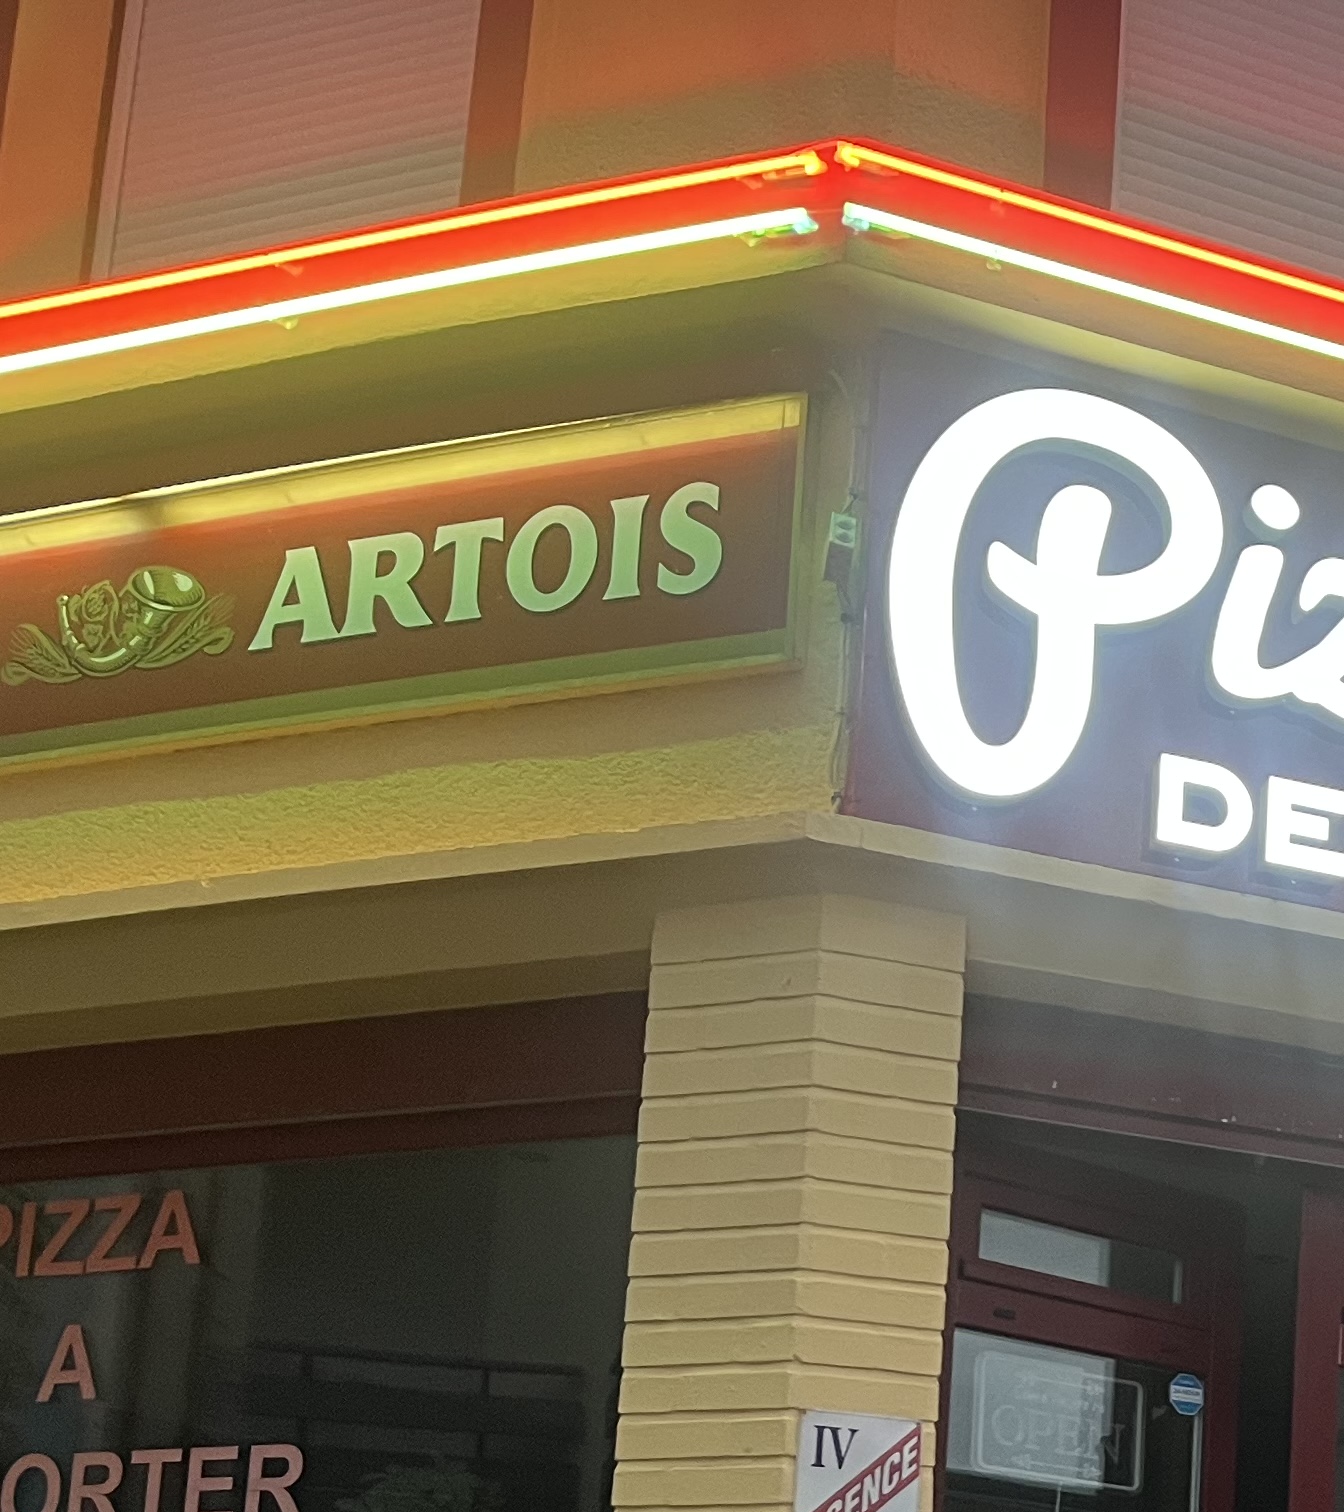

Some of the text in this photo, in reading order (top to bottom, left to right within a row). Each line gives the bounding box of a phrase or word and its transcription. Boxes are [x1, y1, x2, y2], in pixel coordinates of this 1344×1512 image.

[247, 480, 723, 652] ARTOIS
[36, 1323, 96, 1403] A
[811, 1424, 860, 1470] IV
